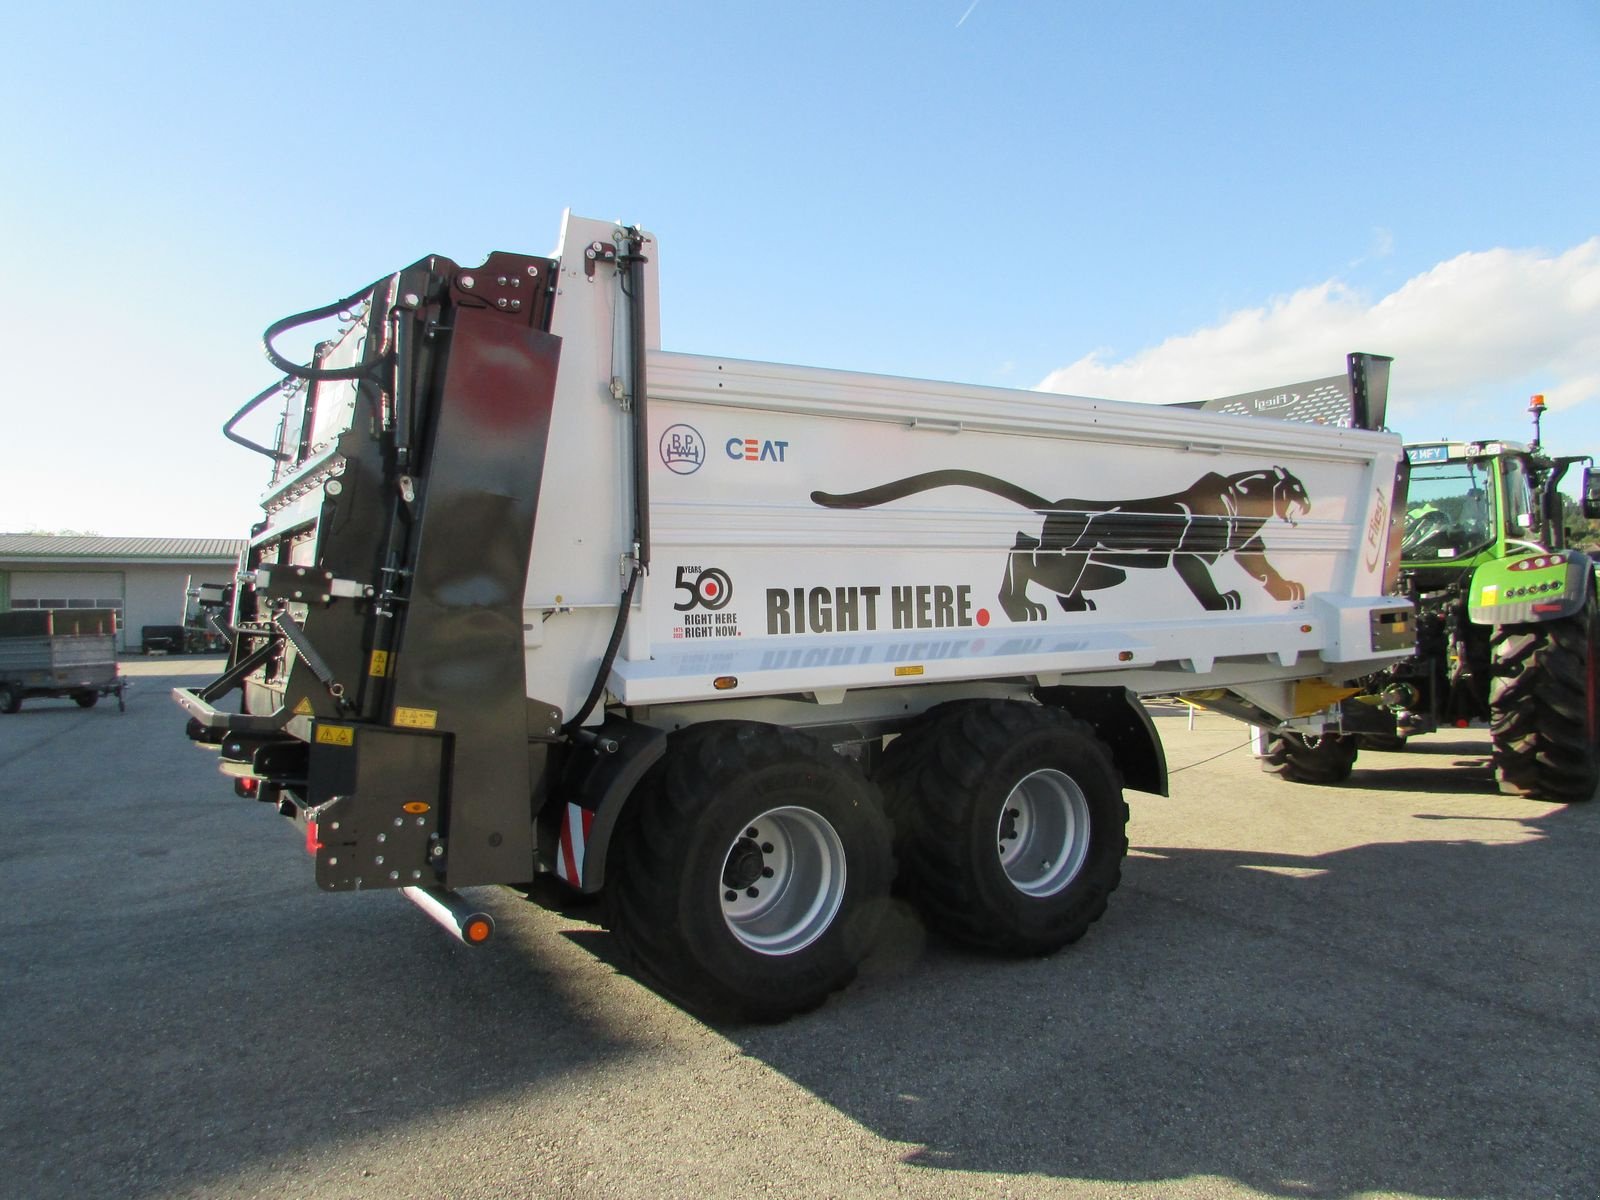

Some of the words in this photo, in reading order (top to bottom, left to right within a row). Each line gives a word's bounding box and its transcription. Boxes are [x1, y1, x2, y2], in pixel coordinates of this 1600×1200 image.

[726, 438, 788, 462] CEAT
[684, 566, 702, 574] YEARS
[674, 566, 733, 611] 50
[766, 586, 881, 635] RIGHT
[891, 584, 990, 630] HERE.
[684, 614, 713, 625] RIGHT
[715, 613, 737, 624] HERE
[685, 627, 713, 638] RIGHT
[715, 626, 741, 637] NOW.
